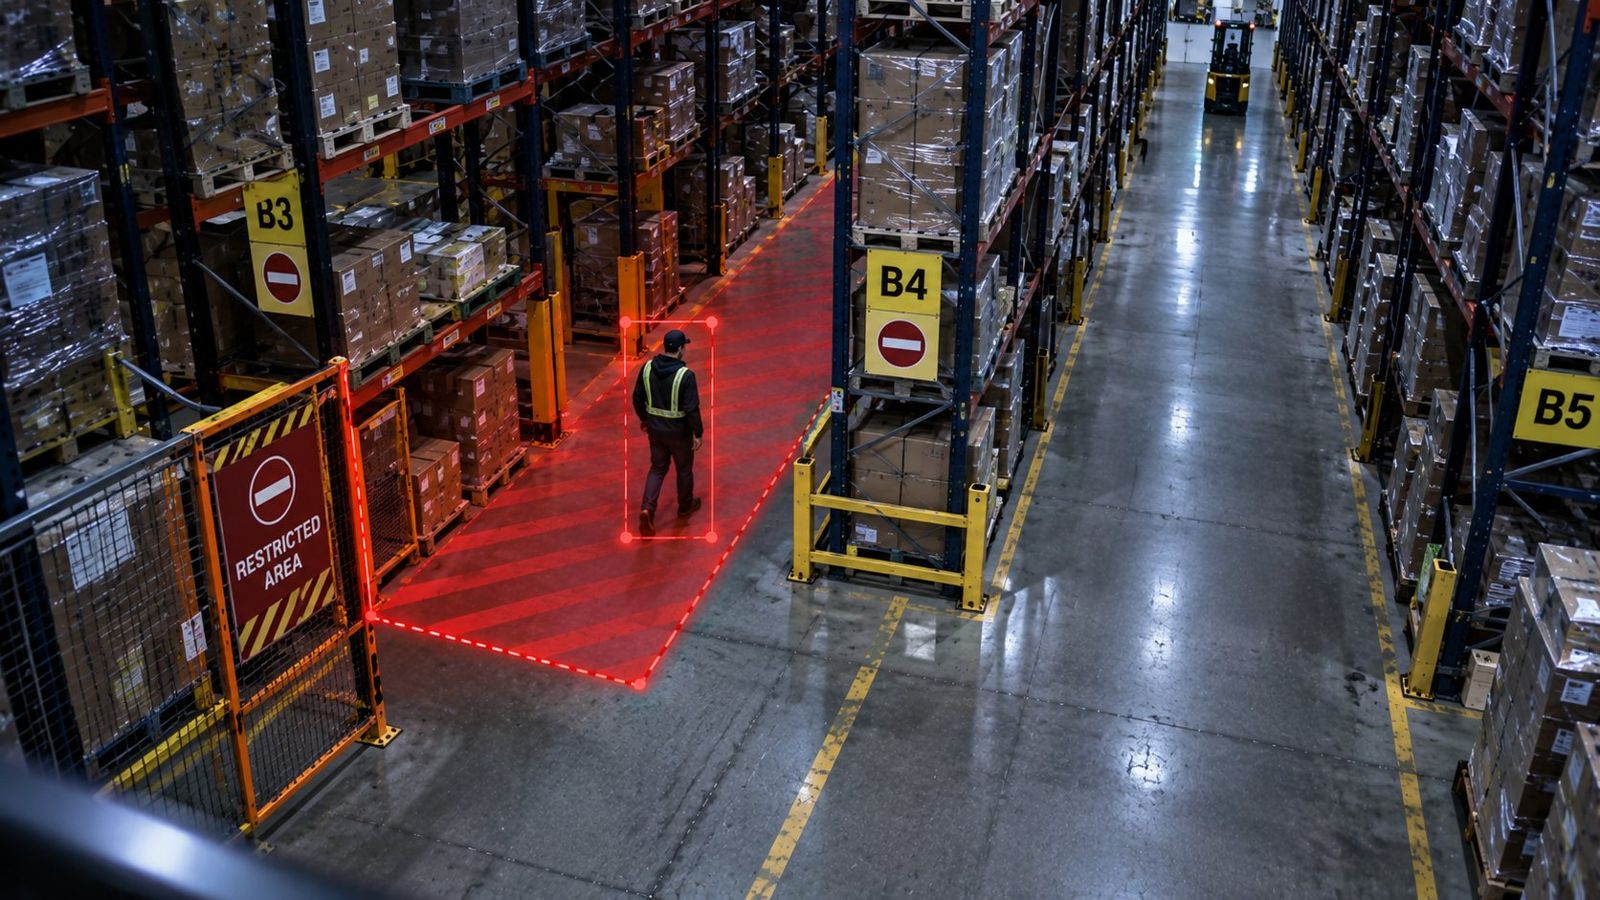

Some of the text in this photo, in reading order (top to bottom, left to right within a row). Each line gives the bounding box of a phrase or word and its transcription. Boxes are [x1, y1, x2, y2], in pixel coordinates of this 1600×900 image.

[256, 196, 294, 231] B3
[880, 265, 928, 301] B4
[1533, 387, 1595, 430] B5
[235, 514, 321, 581] RESTRICTED
[264, 552, 303, 591] AREA
